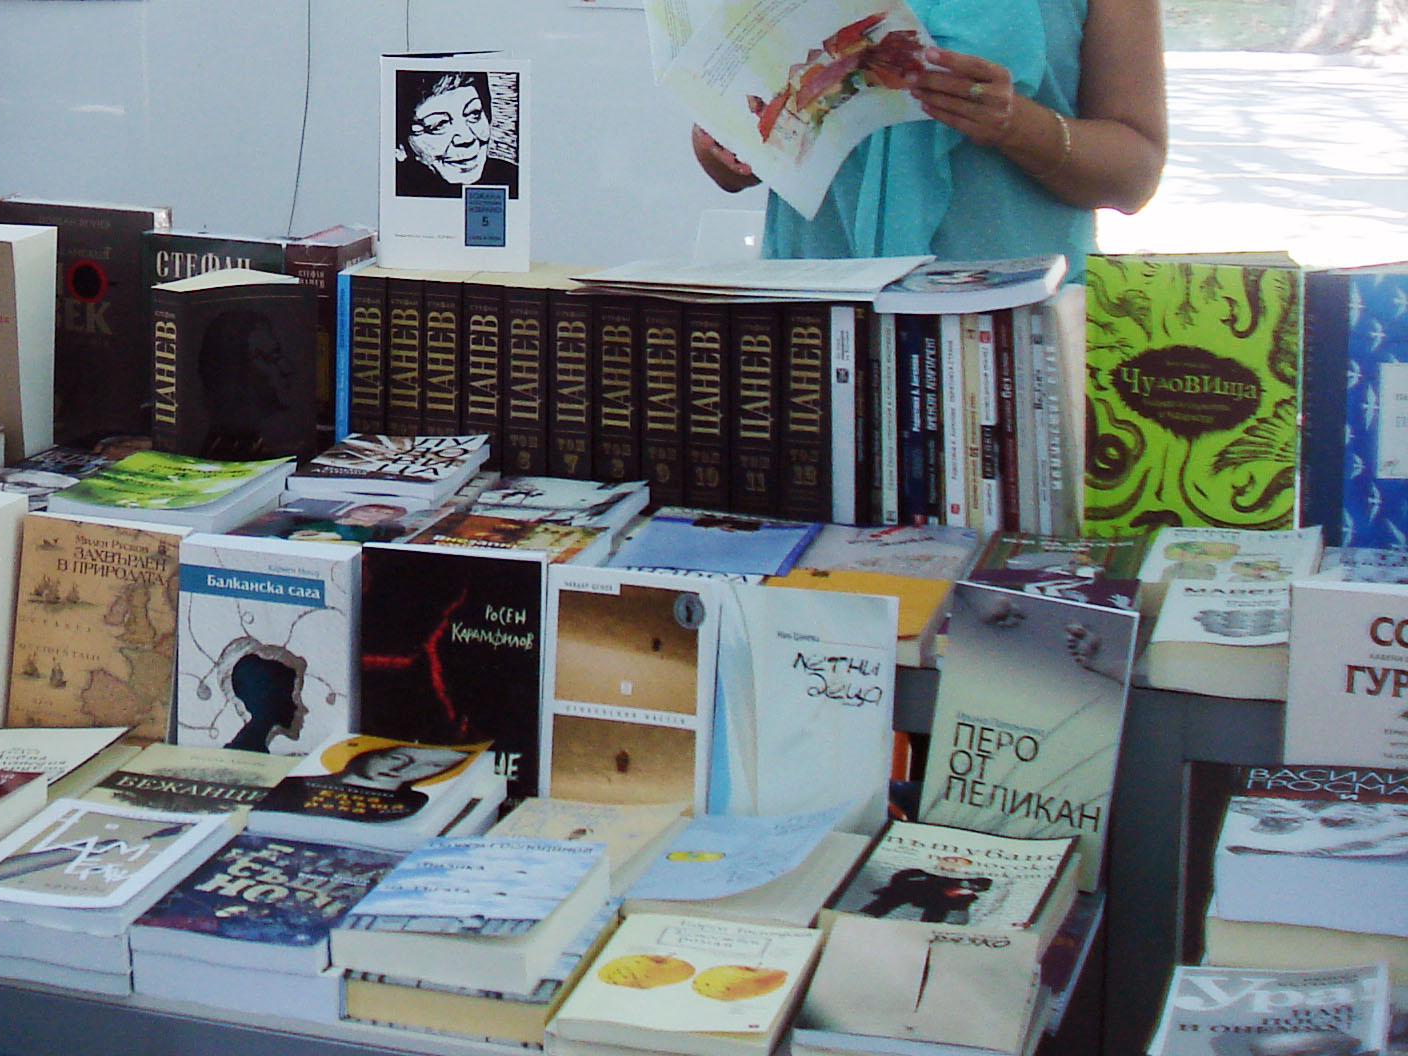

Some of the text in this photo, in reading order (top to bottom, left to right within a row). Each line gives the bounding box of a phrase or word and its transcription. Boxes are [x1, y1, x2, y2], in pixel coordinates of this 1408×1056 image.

[481, 216, 490, 227] 5
[154, 320, 177, 424] ЦАНЕВ
[353, 307, 383, 408] ЦАНЕВ
[391, 309, 421, 410] ЦАНЕВ
[427, 311, 458, 413] ЦАНЕВ
[469, 314, 499, 416] ЦАНЕВ
[511, 318, 541, 421] ЦАНЕВ
[557, 321, 589, 422] ЦАНЕВ
[602, 325, 633, 429] ЦАНЕВ
[646, 328, 679, 432] ЦАНЕВ
[691, 331, 722, 435] ЦАНЕВ
[741, 335, 774, 440] ЦАНЕВ
[790, 327, 822, 432] ЦАНЕВ
[57, 559, 165, 586] В ПРИРОДАТА
[74, 547, 167, 572] ЗАХВЪРЛЕН
[207, 575, 320, 600] Балканска сага
[949, 749, 992, 779] ОТ
[953, 722, 1038, 762] ПЕРО
[946, 776, 1101, 833] ПЕЛИКАН
